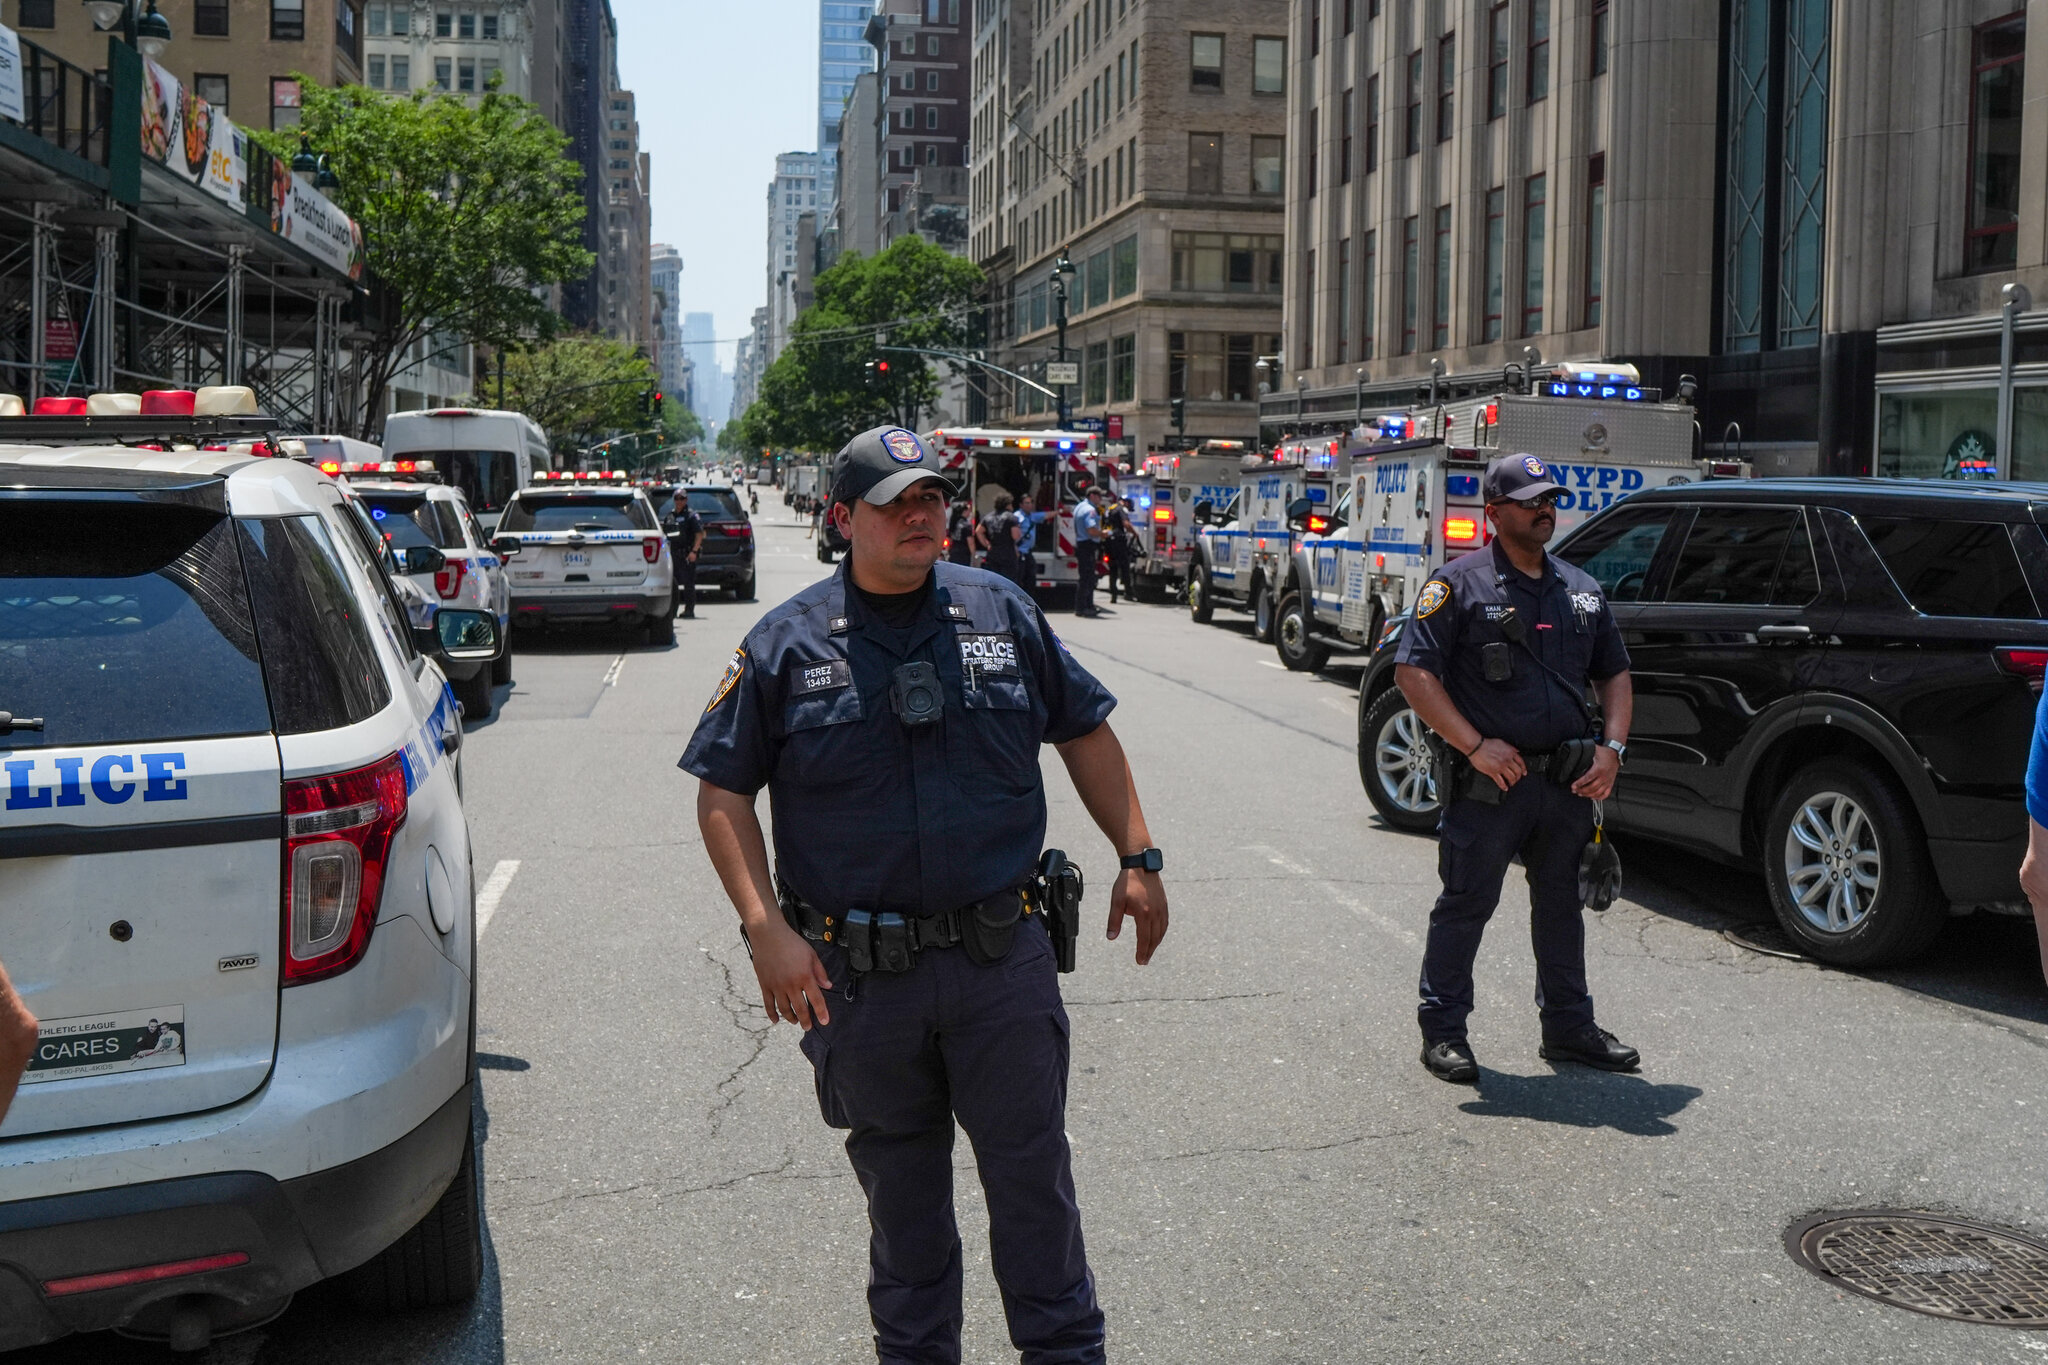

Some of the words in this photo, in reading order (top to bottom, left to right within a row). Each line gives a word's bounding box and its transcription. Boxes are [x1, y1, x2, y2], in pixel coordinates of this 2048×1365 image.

[293, 186, 325, 234] Breakfast
[1375, 462, 1408, 494] POLICE
[1547, 464, 1644, 490] NYPD
[1257, 479, 1280, 499] POLICE
[1556, 490, 1629, 511] OLI
[522, 533, 553, 541] NYPD
[594, 531, 635, 540] POLICE
[1571, 594, 1600, 609] POLICE
[977, 635, 997, 643] NYPD
[961, 641, 1015, 659] POLICE
[962, 657, 993, 665] STRATEGIC
[983, 663, 1004, 671] GROUP
[804, 665, 832, 679] PEREZ
[806, 675, 831, 688] 13493
[4, 752, 188, 811] LICE
[223, 957, 256, 969] AWD
[39, 1025, 77, 1036] THLETIC
[79, 1021, 116, 1032] LEAGUE
[40, 1037, 120, 1061] CARES
[53, 1063, 114, 1076] 1-800-PAL-4KIDS
